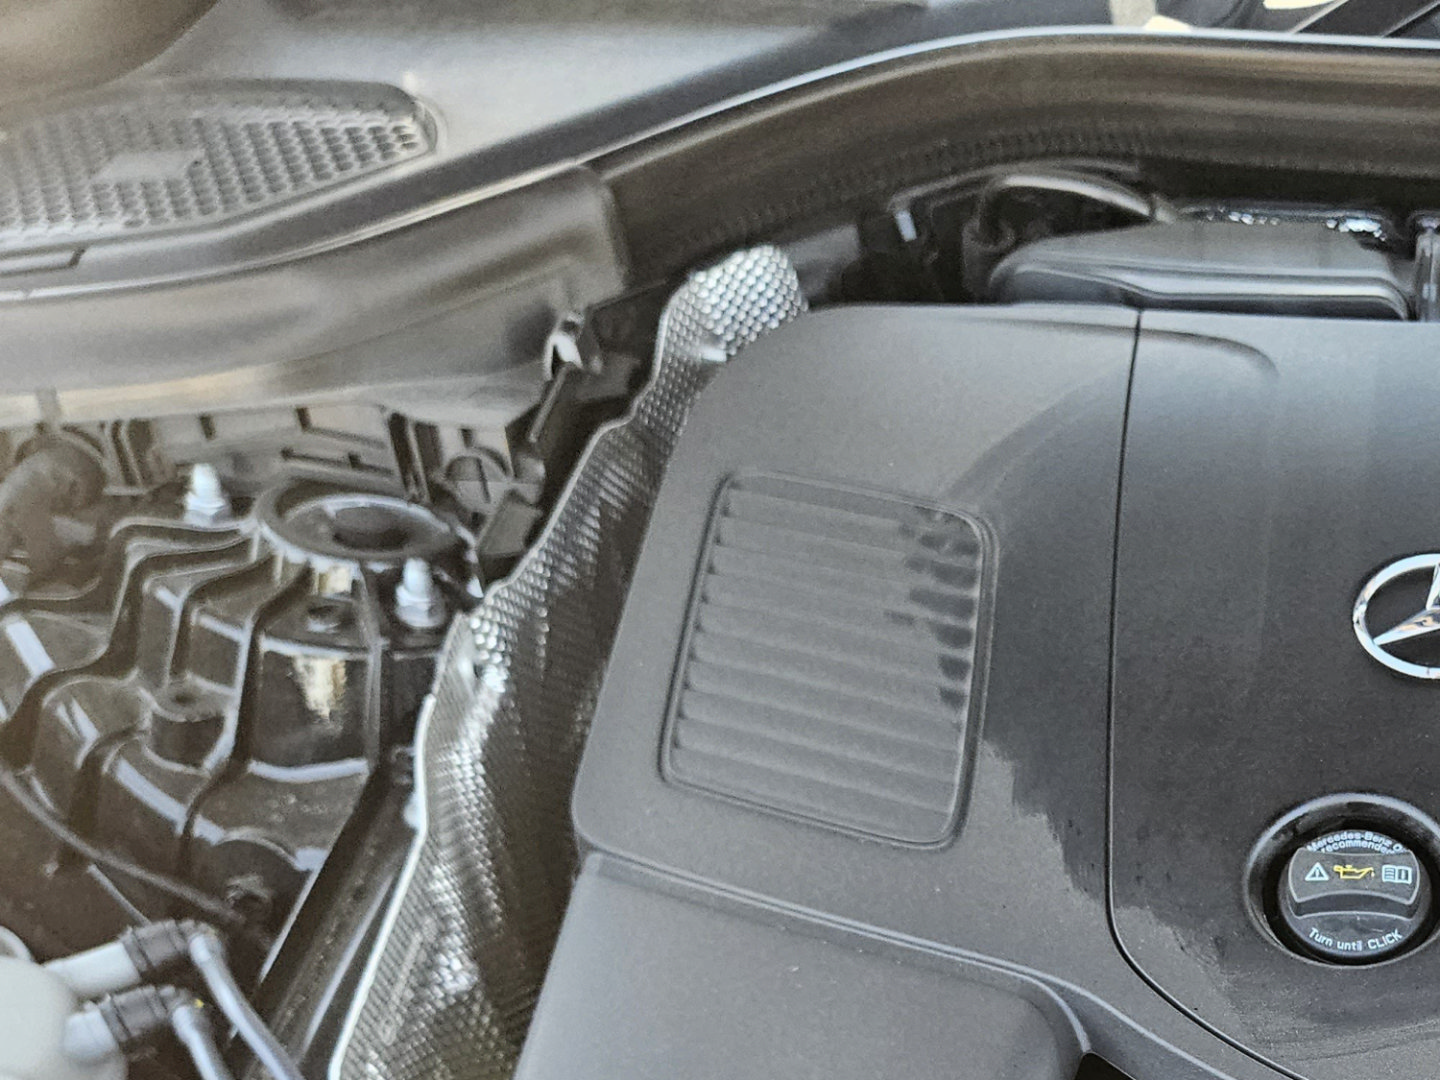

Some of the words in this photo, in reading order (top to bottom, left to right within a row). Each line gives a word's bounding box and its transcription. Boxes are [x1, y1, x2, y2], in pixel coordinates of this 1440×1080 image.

[1306, 831, 1392, 852] Mercedes-Benz
[1308, 927, 1333, 947] Turn
[1336, 940, 1363, 951] until
[1367, 928, 1403, 950] CLICK
